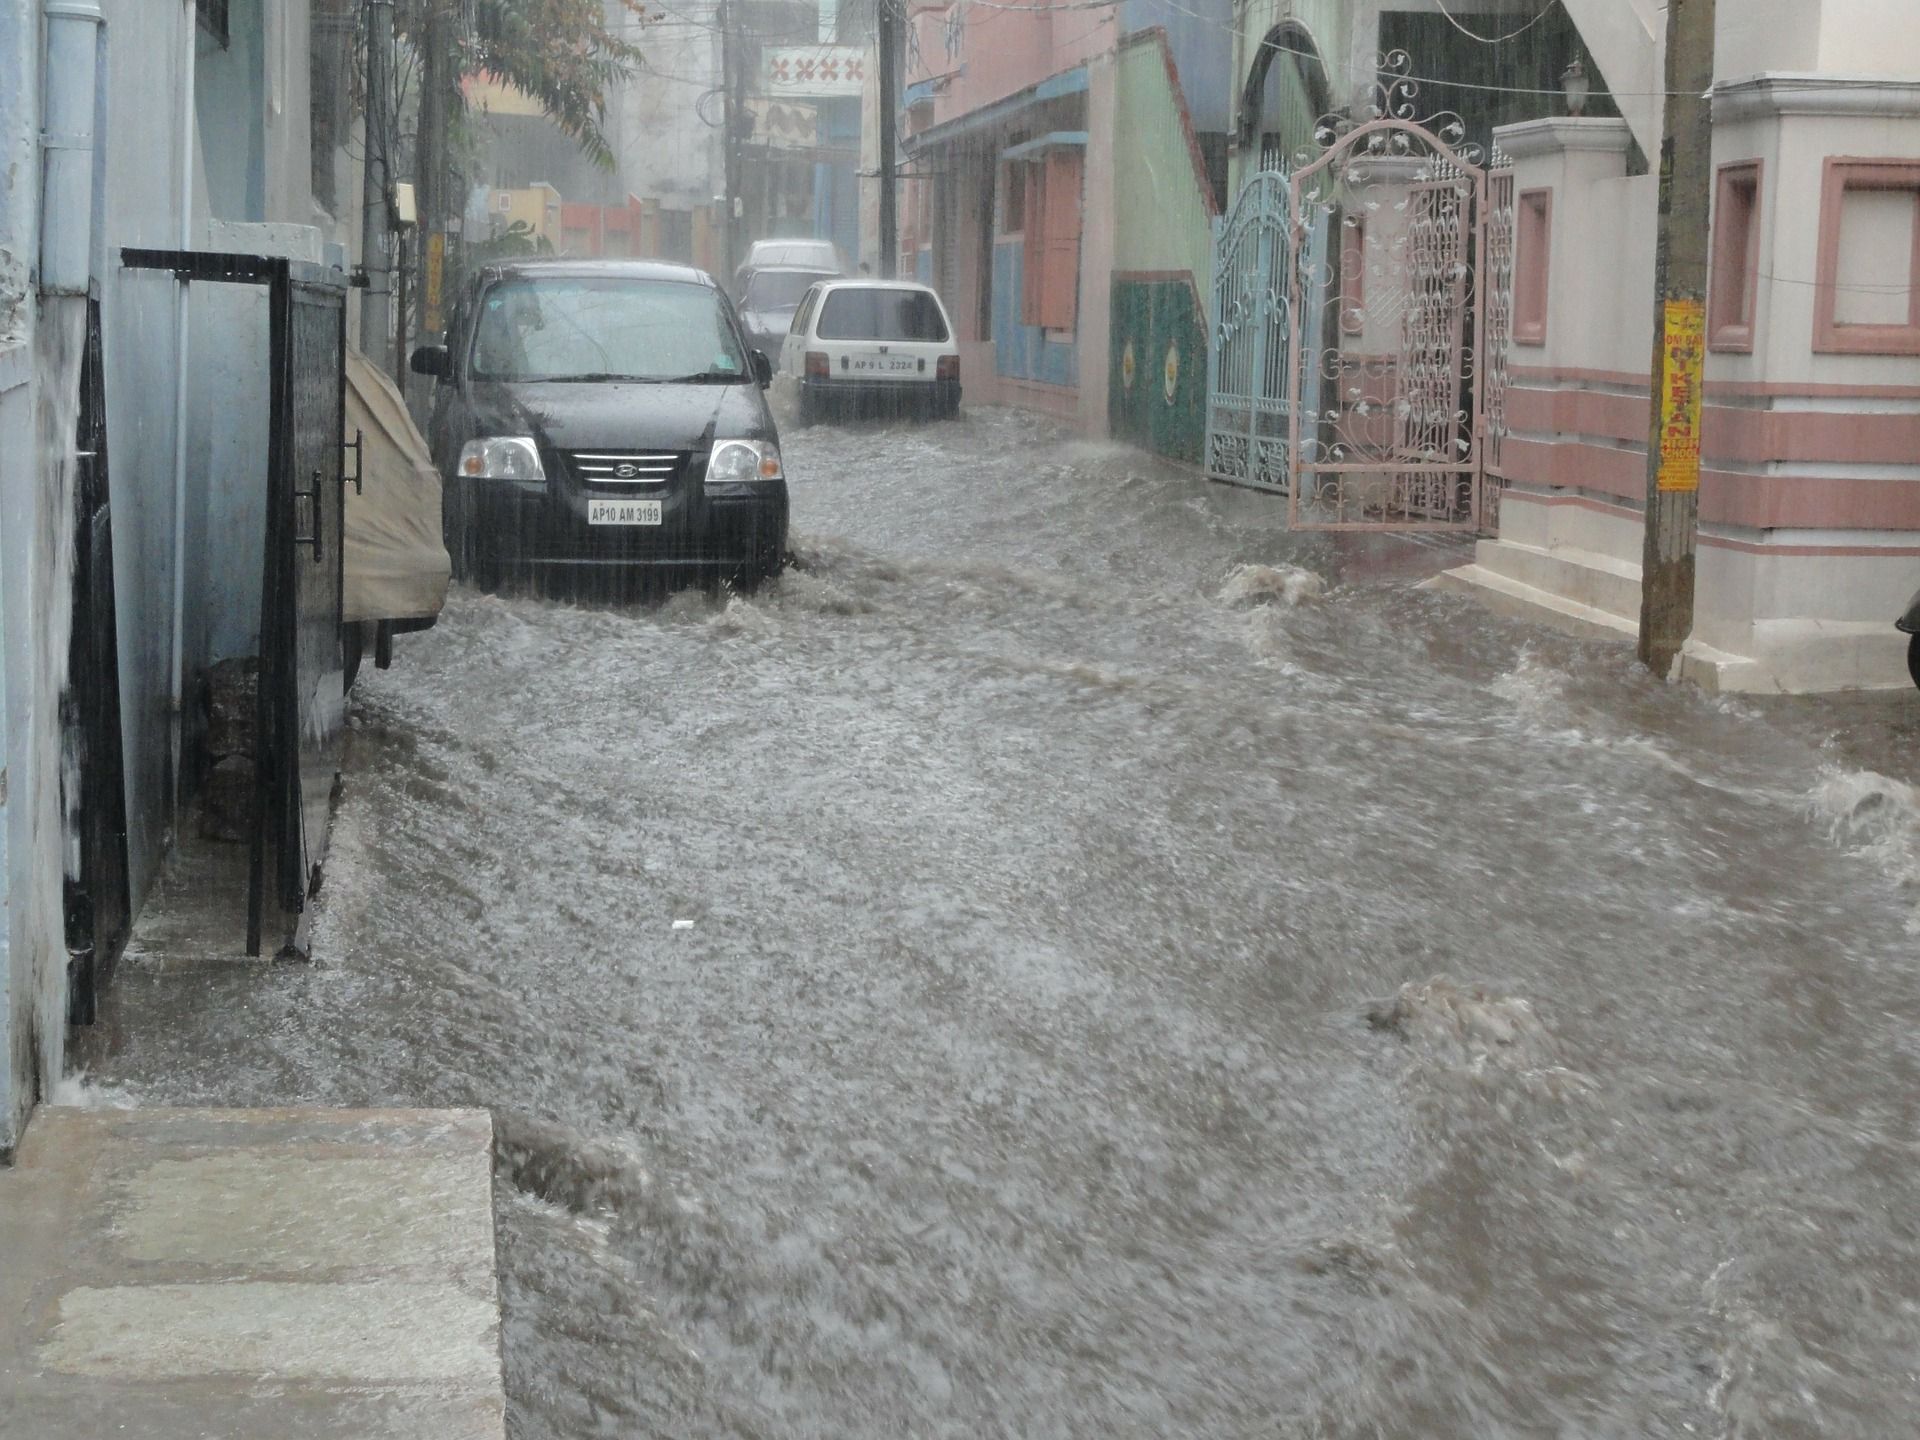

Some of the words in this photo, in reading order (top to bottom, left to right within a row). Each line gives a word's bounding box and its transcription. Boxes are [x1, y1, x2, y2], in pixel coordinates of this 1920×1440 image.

[855, 361, 867, 370] AP
[1662, 438, 1699, 449] HIGH
[1660, 448, 1699, 459] SCHOOL
[592, 507, 616, 521] AP10
[620, 507, 635, 521] AM
[636, 507, 659, 522] 3199
